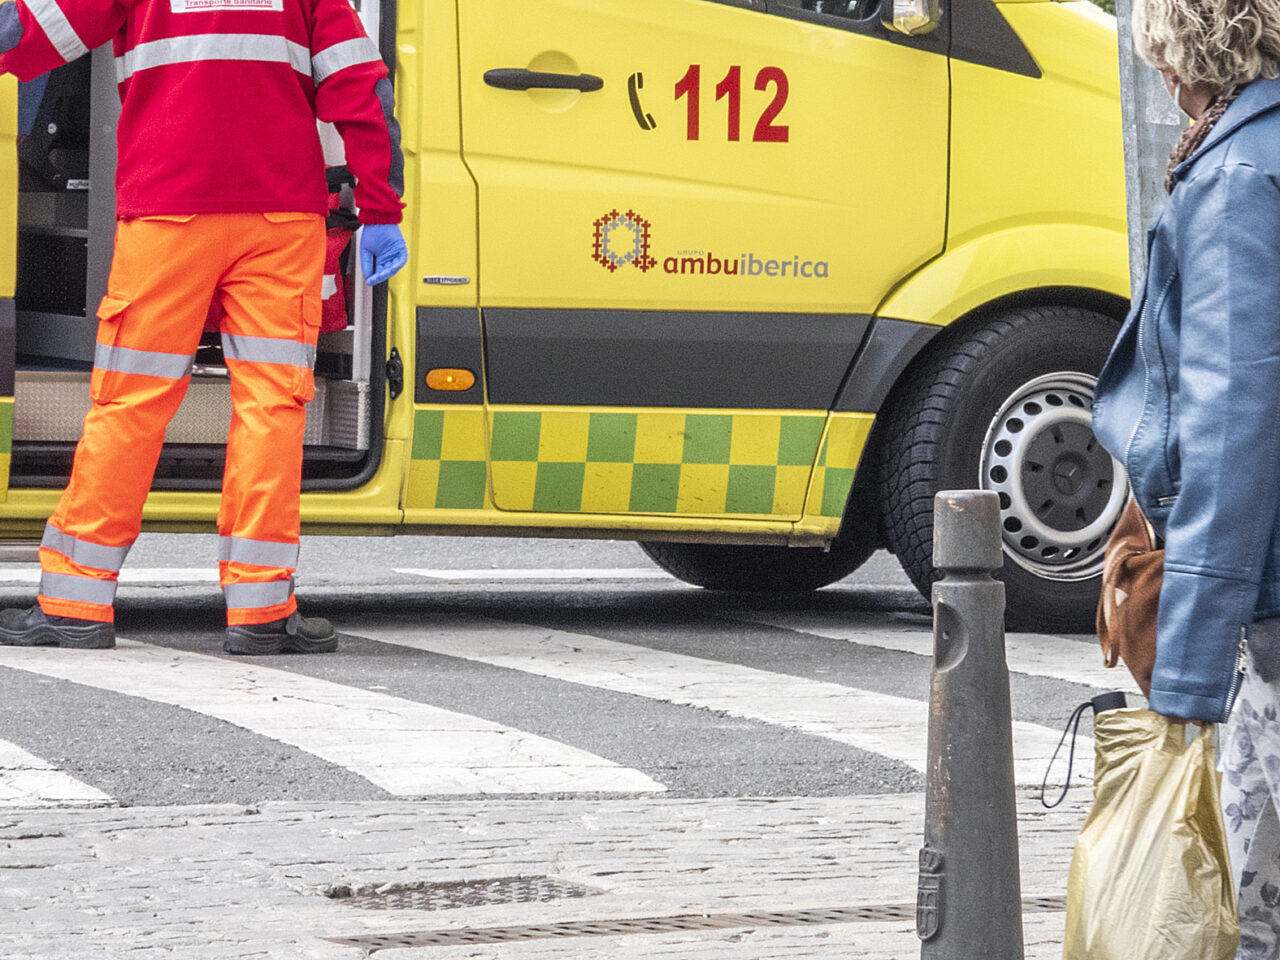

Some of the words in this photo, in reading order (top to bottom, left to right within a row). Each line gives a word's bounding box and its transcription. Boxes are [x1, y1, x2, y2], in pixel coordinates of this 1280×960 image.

[184, 0, 231, 7] Transporte
[674, 63, 790, 144] 112
[663, 251, 829, 279] ambuiberica
